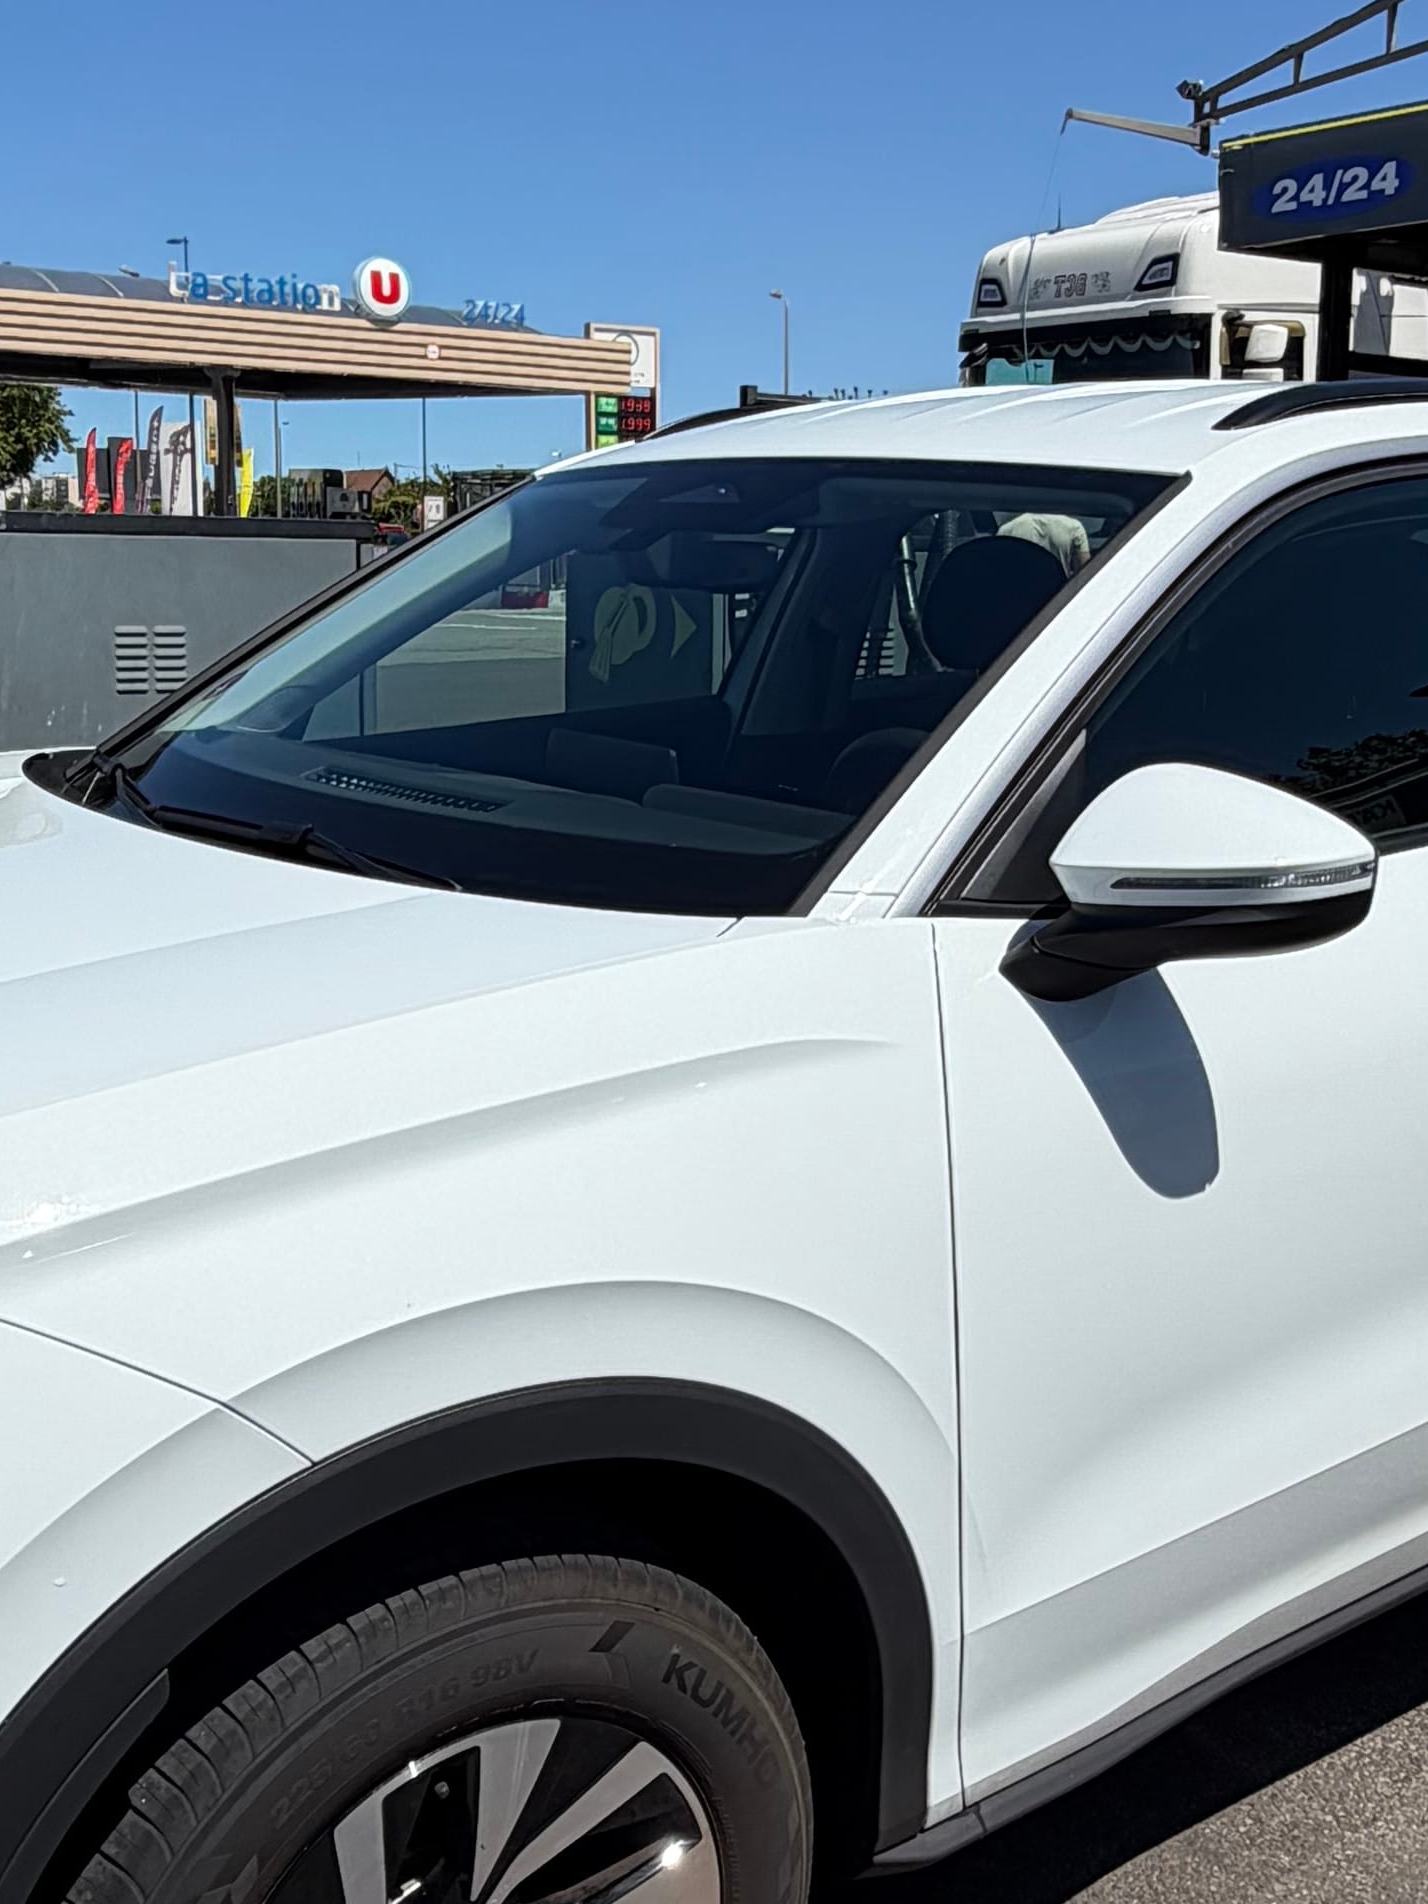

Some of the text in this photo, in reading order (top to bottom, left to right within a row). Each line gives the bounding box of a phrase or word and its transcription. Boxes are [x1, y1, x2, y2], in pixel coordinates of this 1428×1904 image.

[1271, 160, 1400, 214] 24/24
[221, 272, 342, 313] station
[370, 270, 400, 305] U
[464, 299, 525, 326] 24/24
